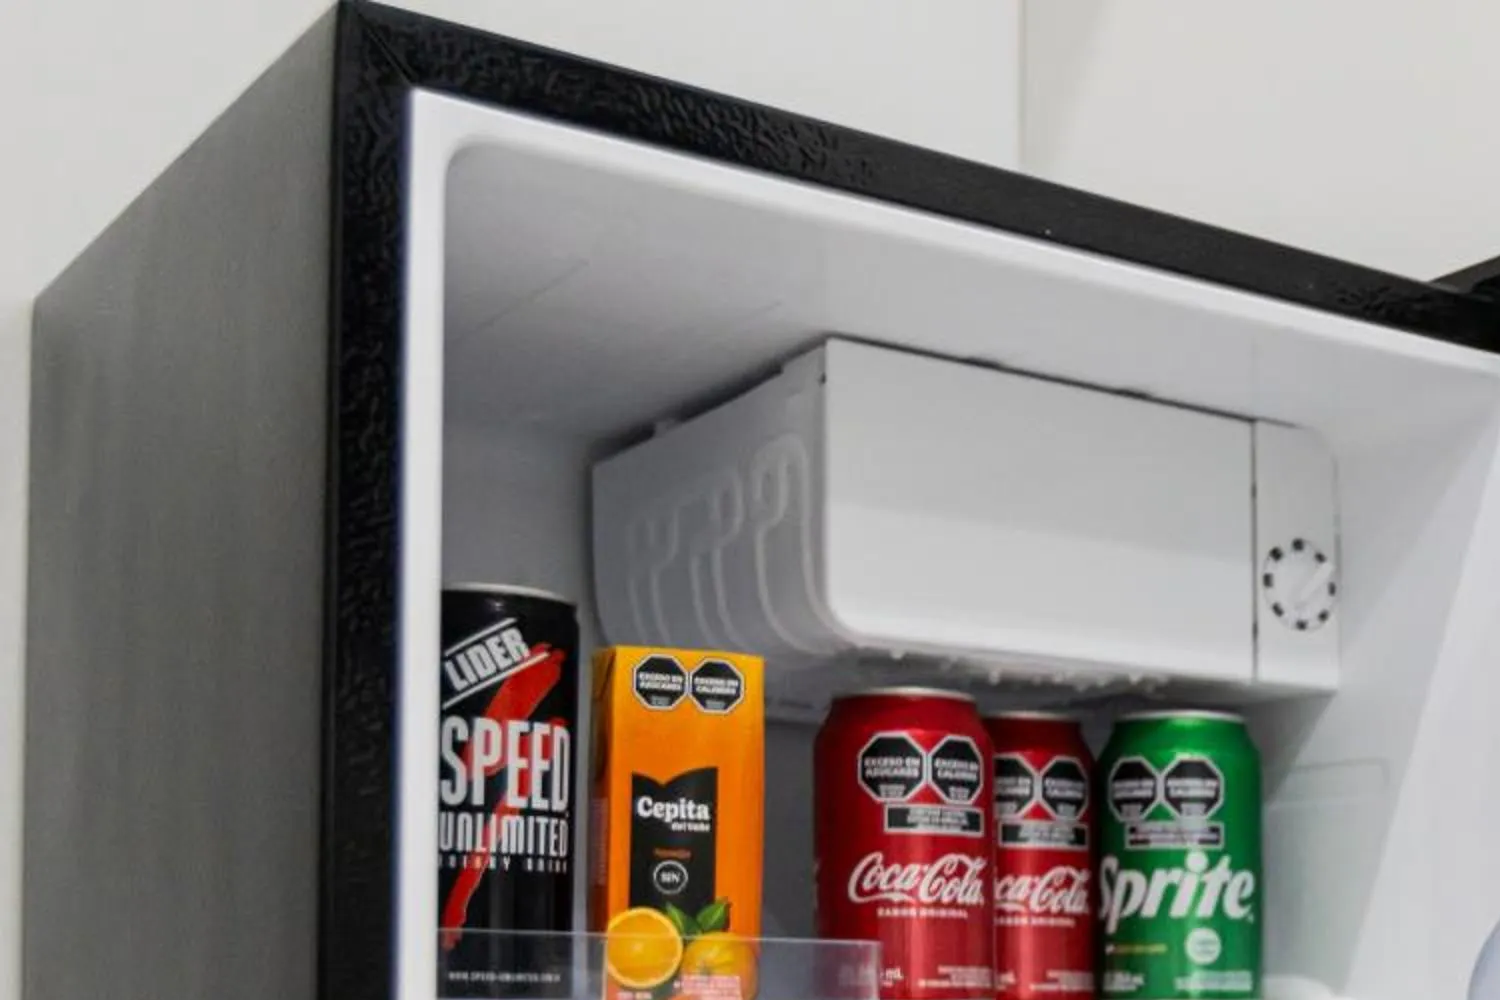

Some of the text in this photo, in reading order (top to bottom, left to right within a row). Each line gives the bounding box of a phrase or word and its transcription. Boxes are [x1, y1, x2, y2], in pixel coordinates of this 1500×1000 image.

[445, 626, 531, 692] LIDER
[440, 714, 571, 812] SPEED
[438, 811, 569, 858] UNLIMITED
[637, 795, 711, 823] Cepita
[848, 851, 987, 906] Coca-Cola
[995, 865, 1091, 914] ca-Cola
[1099, 850, 1256, 936] Sprite
